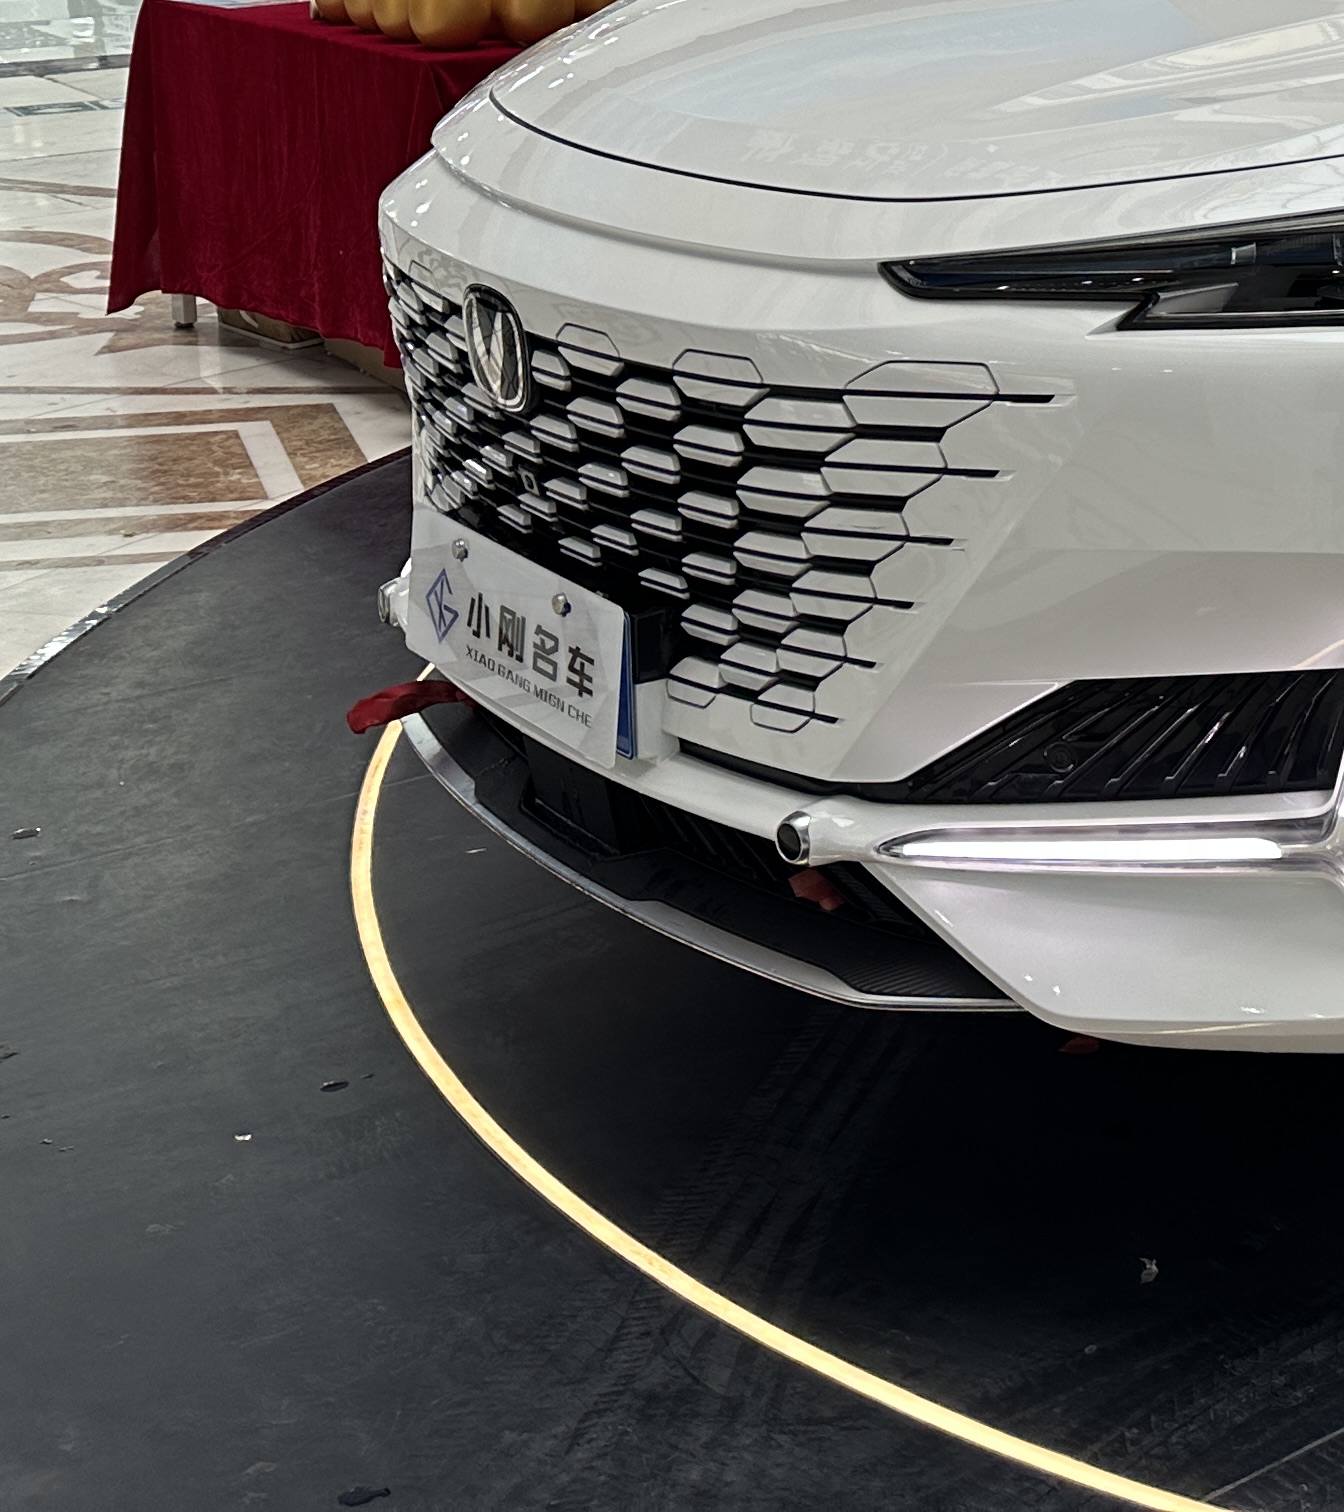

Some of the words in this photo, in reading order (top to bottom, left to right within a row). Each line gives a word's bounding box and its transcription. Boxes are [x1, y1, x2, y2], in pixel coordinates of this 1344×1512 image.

[466, 644, 495, 673] XIAO
[497, 663, 531, 693] GANG
[533, 684, 565, 713] MIGN
[568, 704, 593, 729] CHE
[467, 592, 595, 698] 小刚名车
